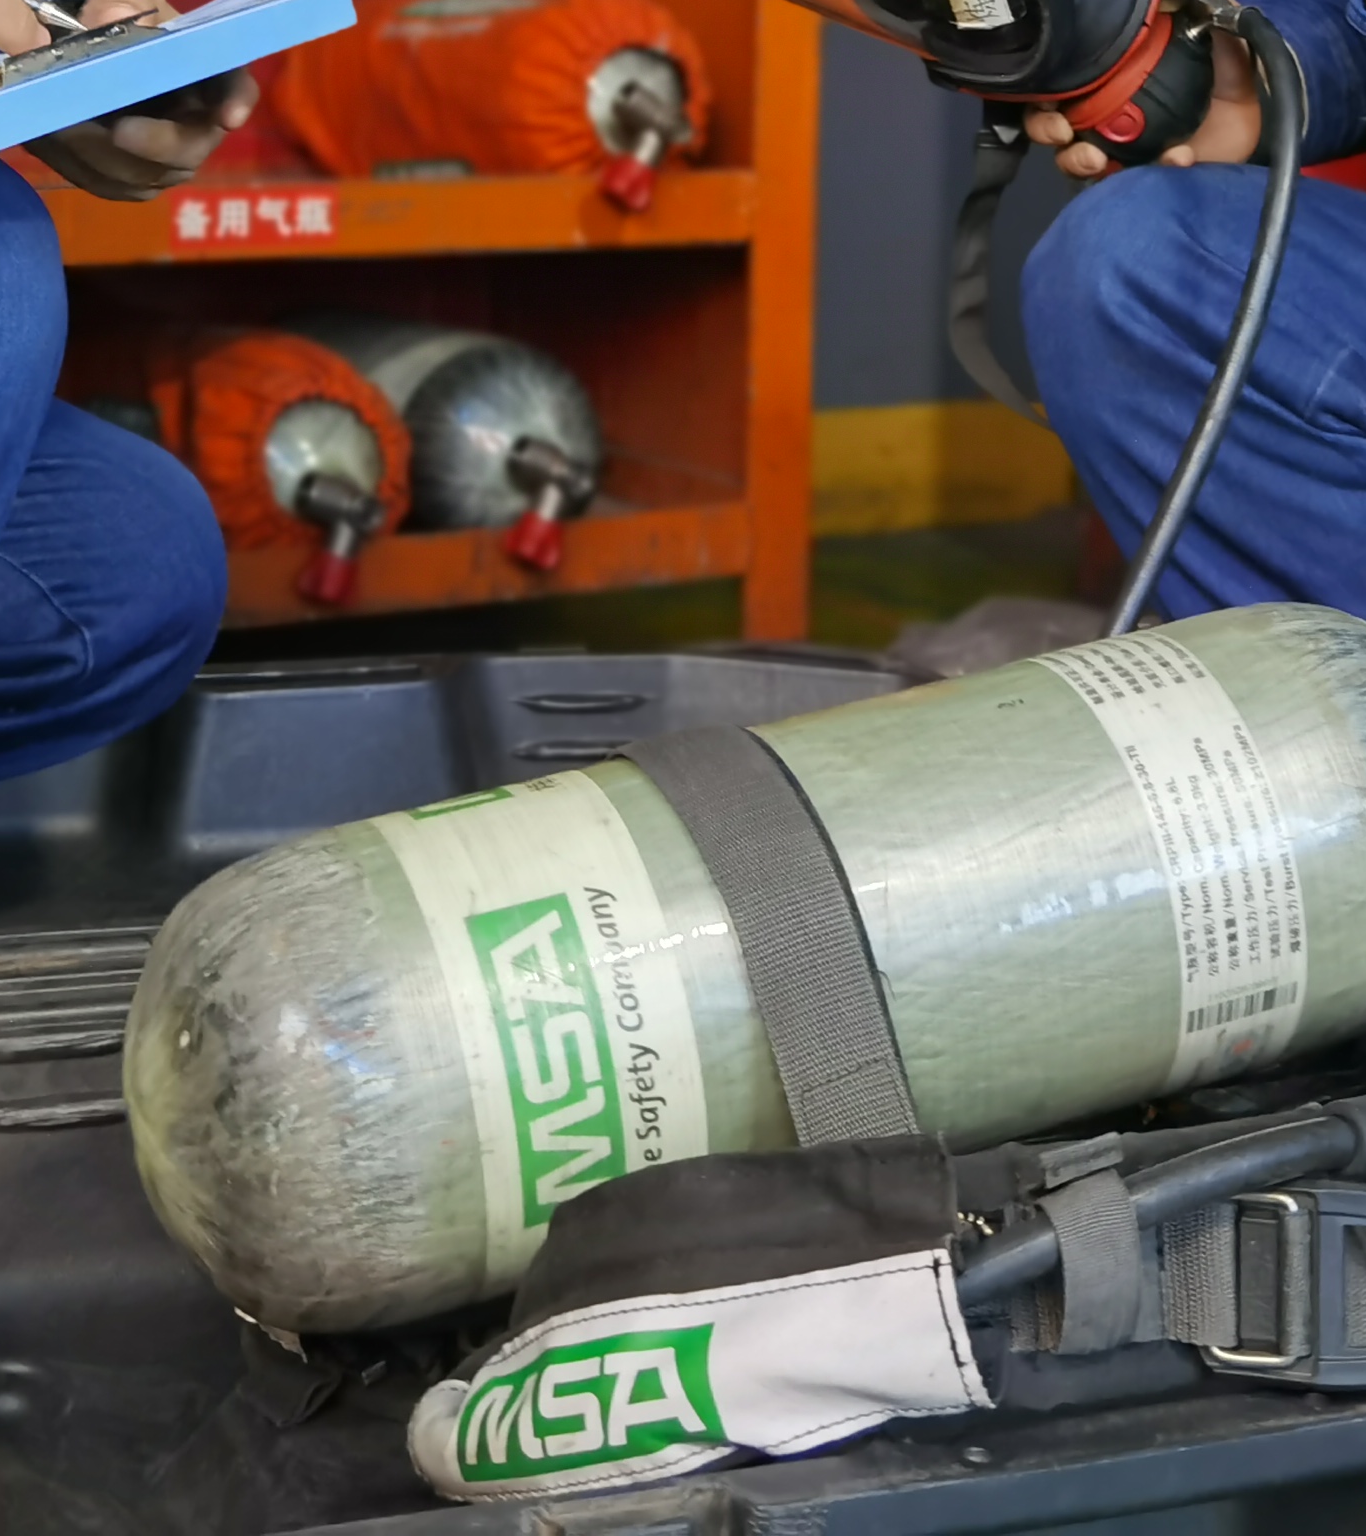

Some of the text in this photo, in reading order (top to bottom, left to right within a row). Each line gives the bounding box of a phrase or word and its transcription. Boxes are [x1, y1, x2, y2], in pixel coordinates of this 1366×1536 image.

[174, 196, 333, 240] 备用气瓶
[1193, 736, 1219, 779] 30MPa
[491, 909, 614, 1206] MSA
[628, 1042, 668, 1139] Safety
[465, 1345, 708, 1465] MSA
